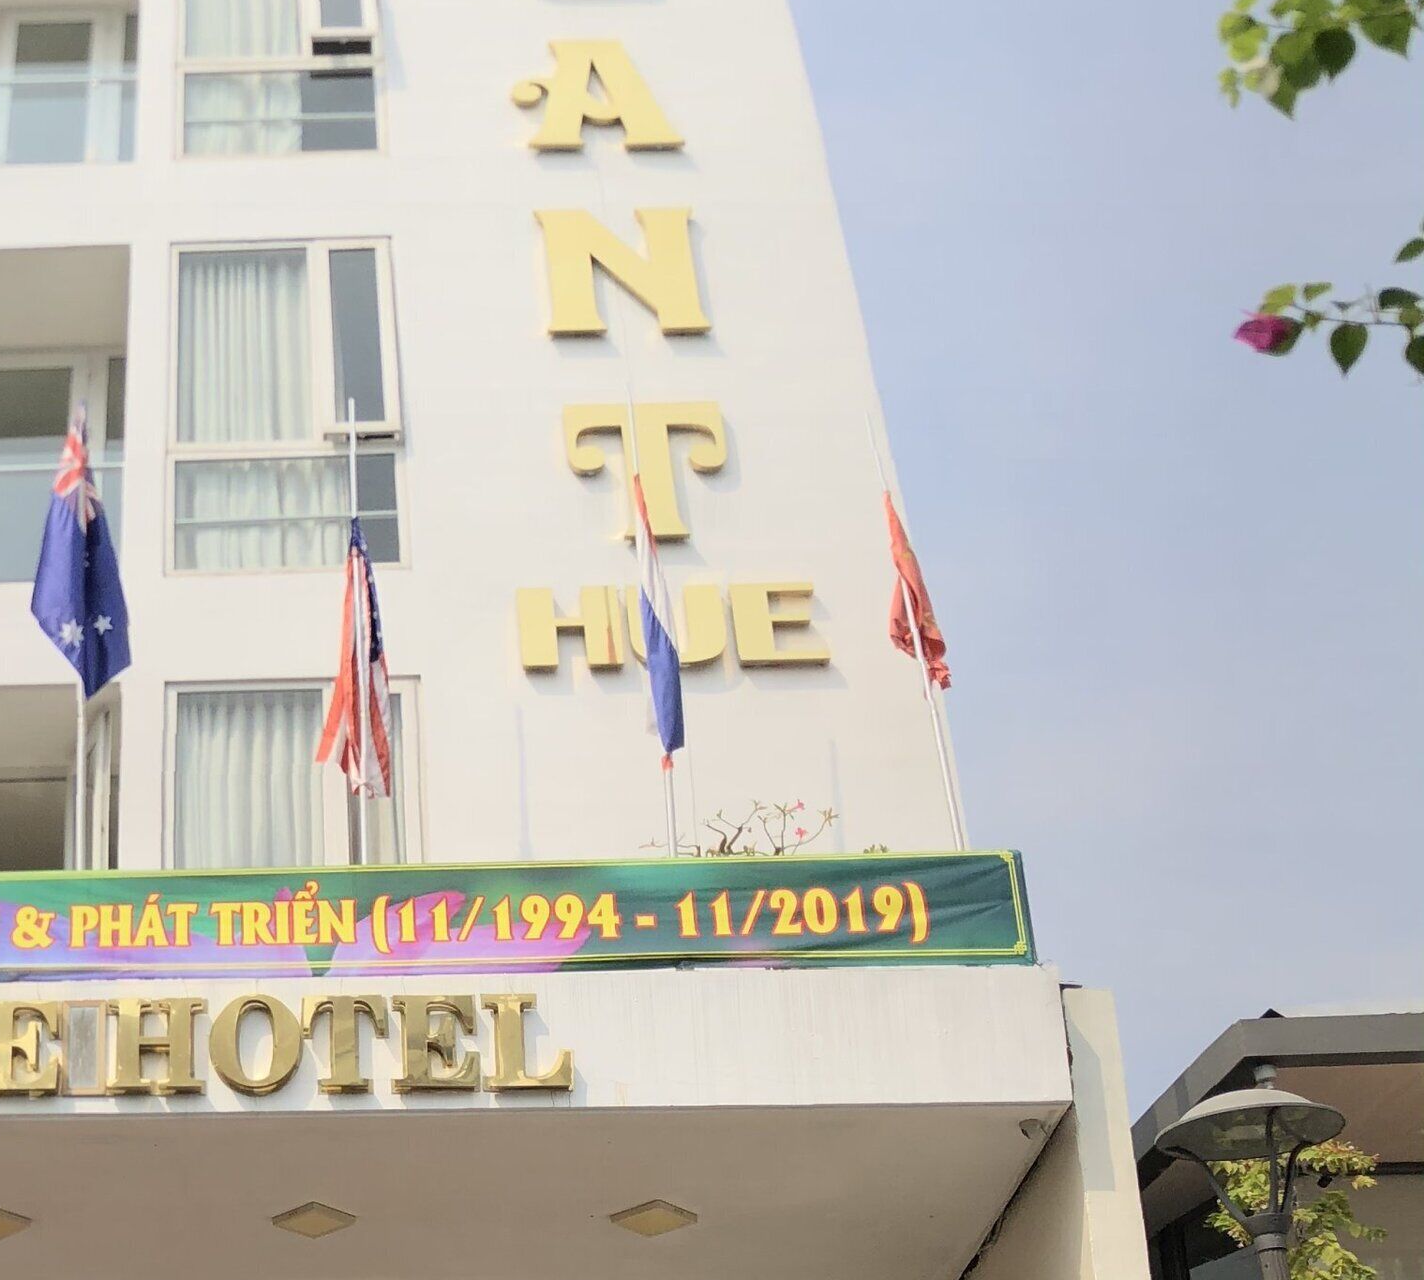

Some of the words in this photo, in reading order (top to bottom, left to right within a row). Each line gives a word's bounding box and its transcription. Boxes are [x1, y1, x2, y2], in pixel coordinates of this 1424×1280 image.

[516, 581, 831, 673] HUE
[12, 906, 54, 949] &
[69, 893, 197, 949] PHÁT
[209, 880, 357, 948] TRIỂN
[372, 892, 622, 953] (11/1994
[678, 882, 932, 943] 11/2019)
[105, 992, 575, 1097] HOTEL
